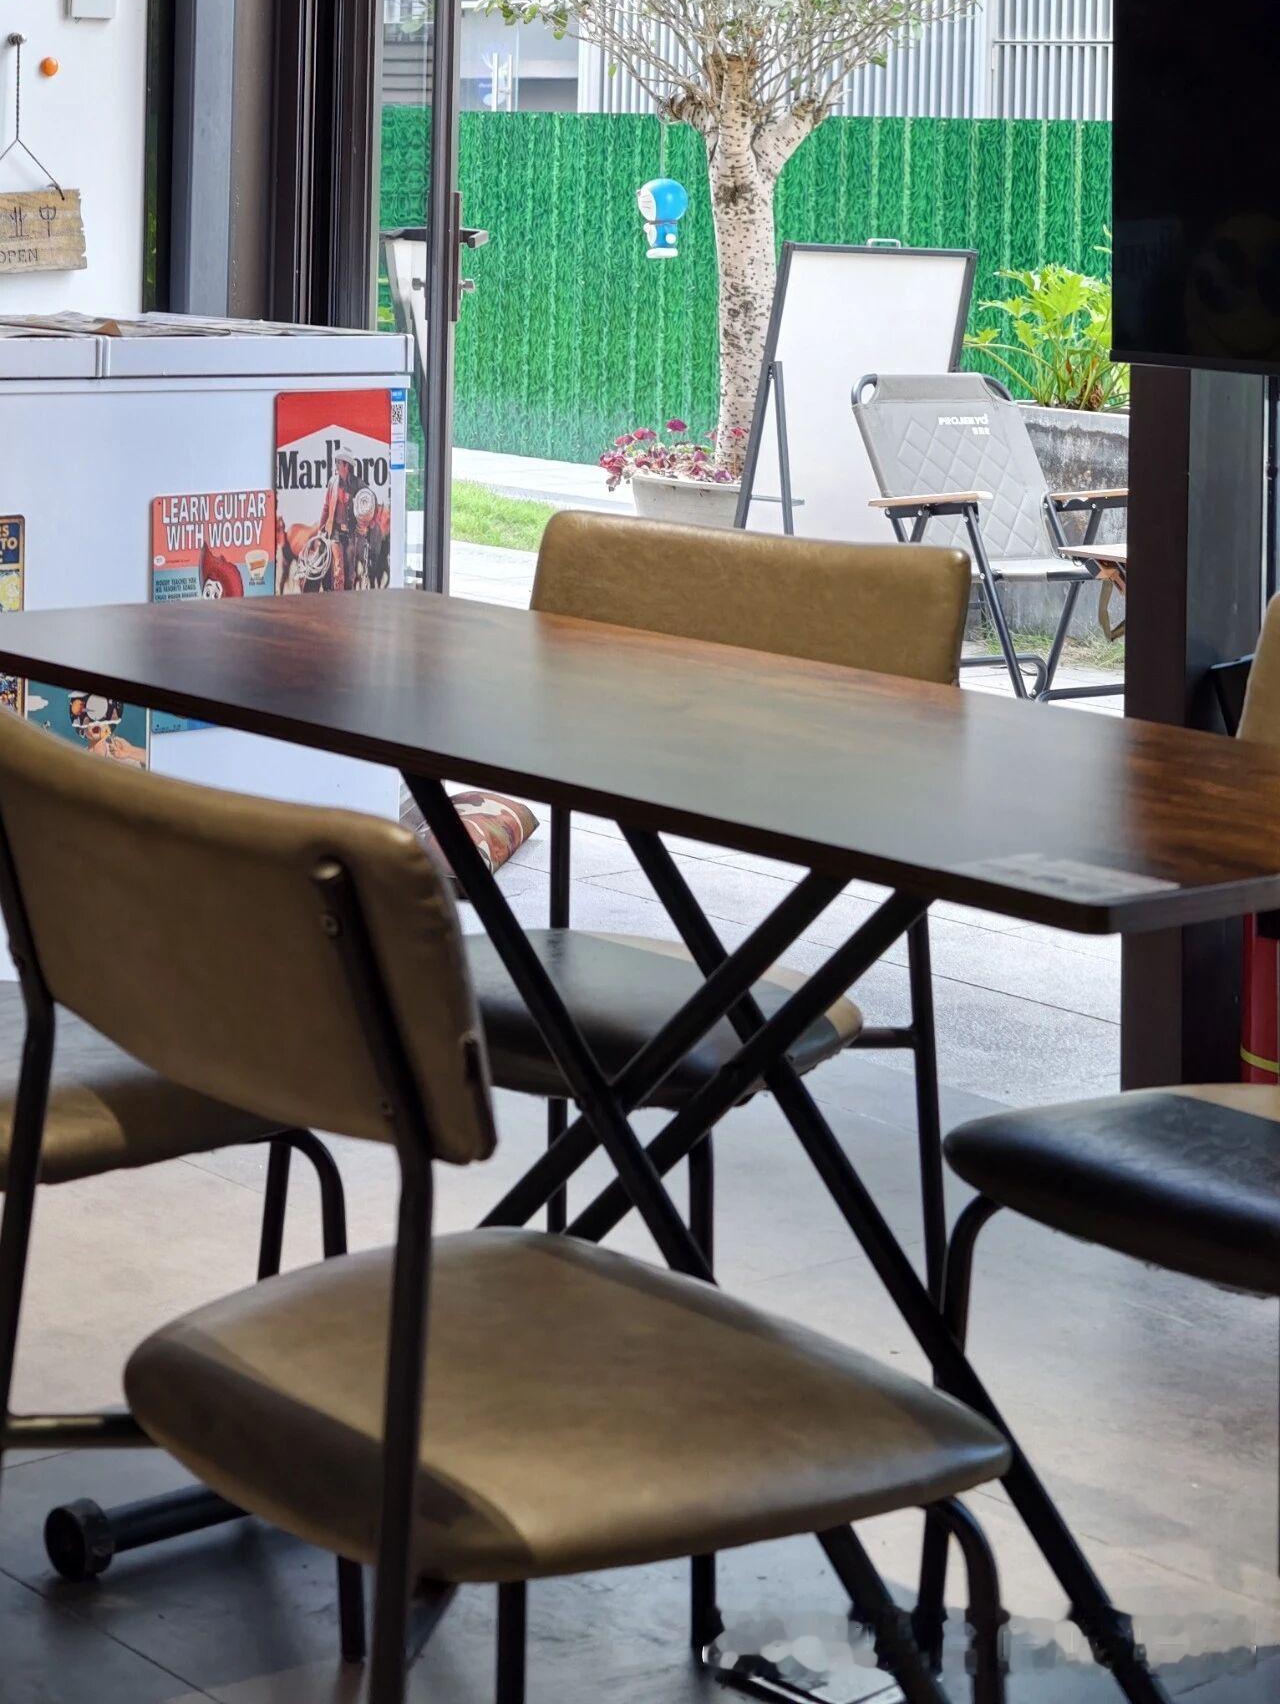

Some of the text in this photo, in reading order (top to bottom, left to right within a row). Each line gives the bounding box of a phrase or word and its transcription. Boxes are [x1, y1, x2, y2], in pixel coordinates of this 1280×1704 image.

[276, 439, 389, 490] Marlro
[162, 492, 267, 524] LEARN GUITAR
[0, 537, 18, 550] TO
[166, 519, 263, 552] WITH WOODY
